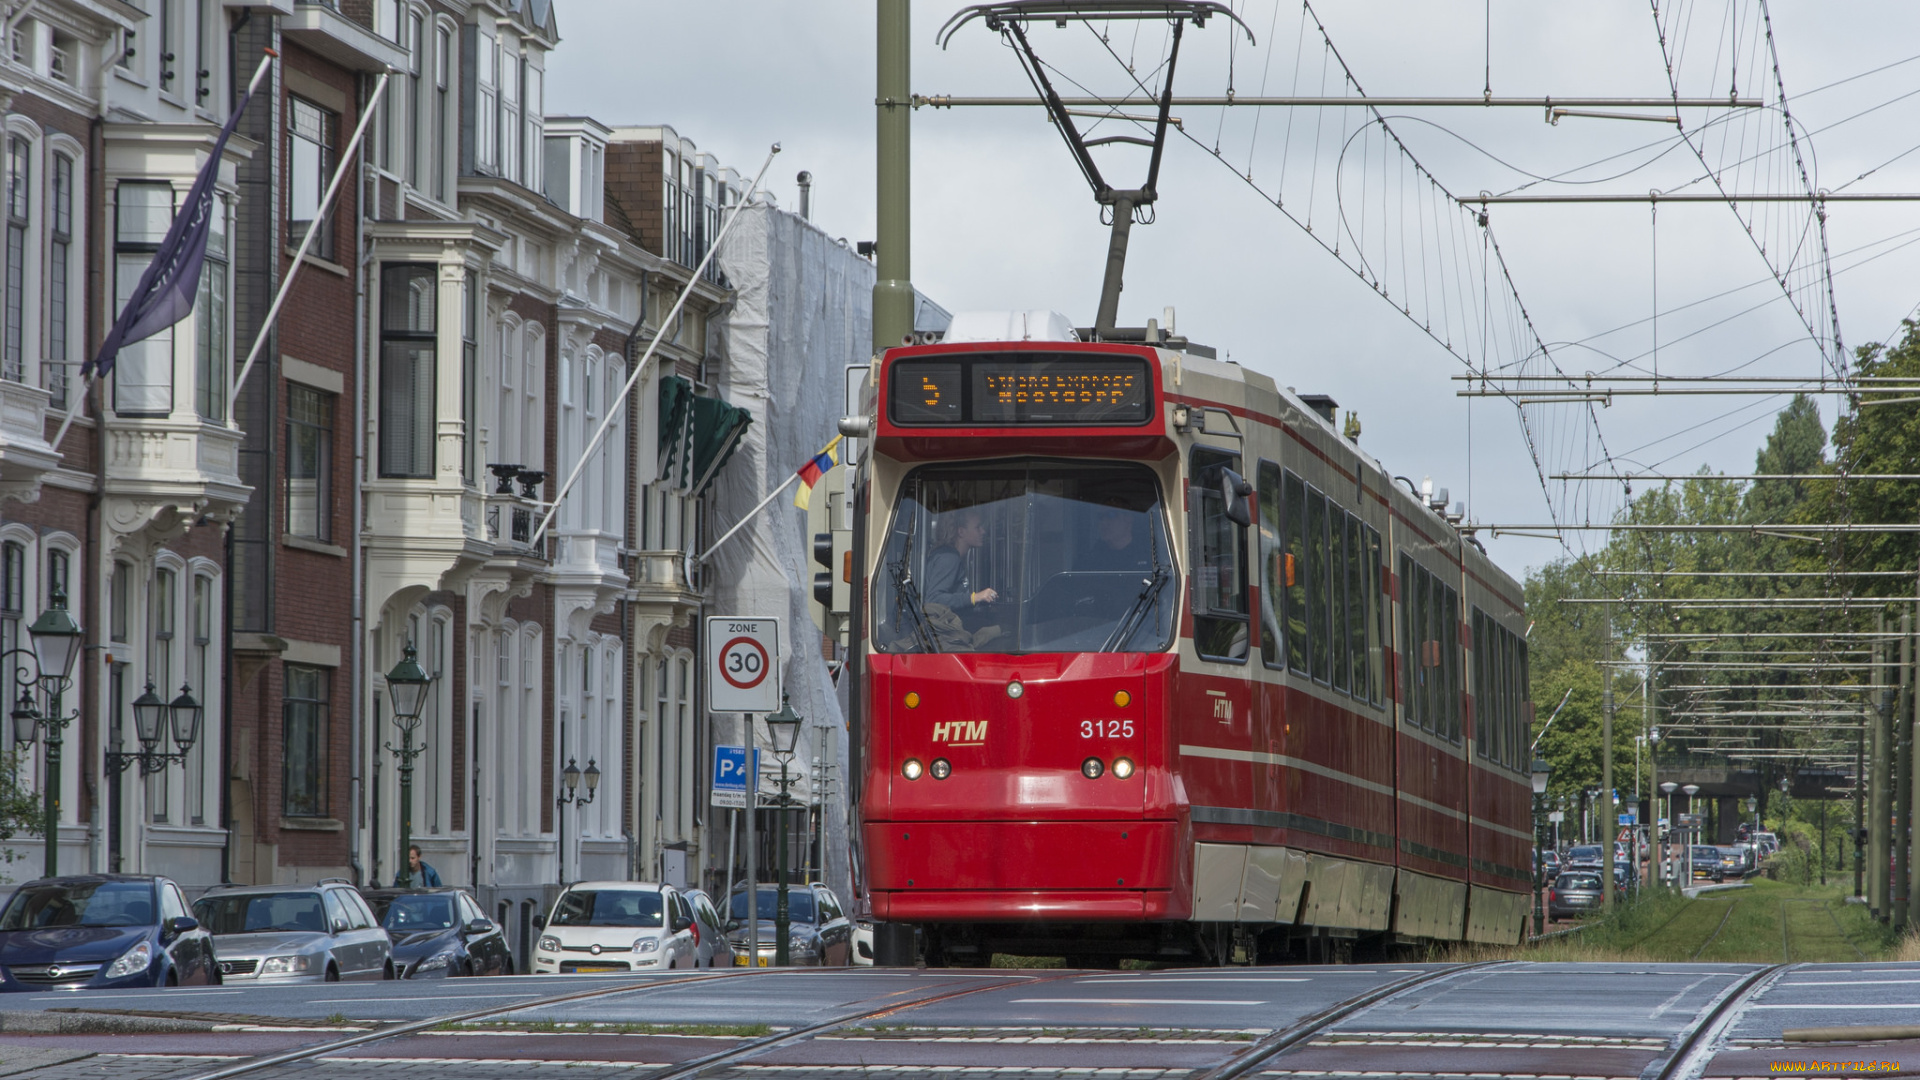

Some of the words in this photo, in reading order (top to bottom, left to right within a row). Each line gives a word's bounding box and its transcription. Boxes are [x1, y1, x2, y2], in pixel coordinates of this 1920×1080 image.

[923, 377, 940, 405] 5
[728, 623, 758, 633] ZONE
[728, 652, 760, 673] 30
[1213, 698, 1232, 719] HTM
[932, 720, 988, 743] HTM
[1080, 720, 1134, 739] 3125
[720, 759, 735, 778] P
